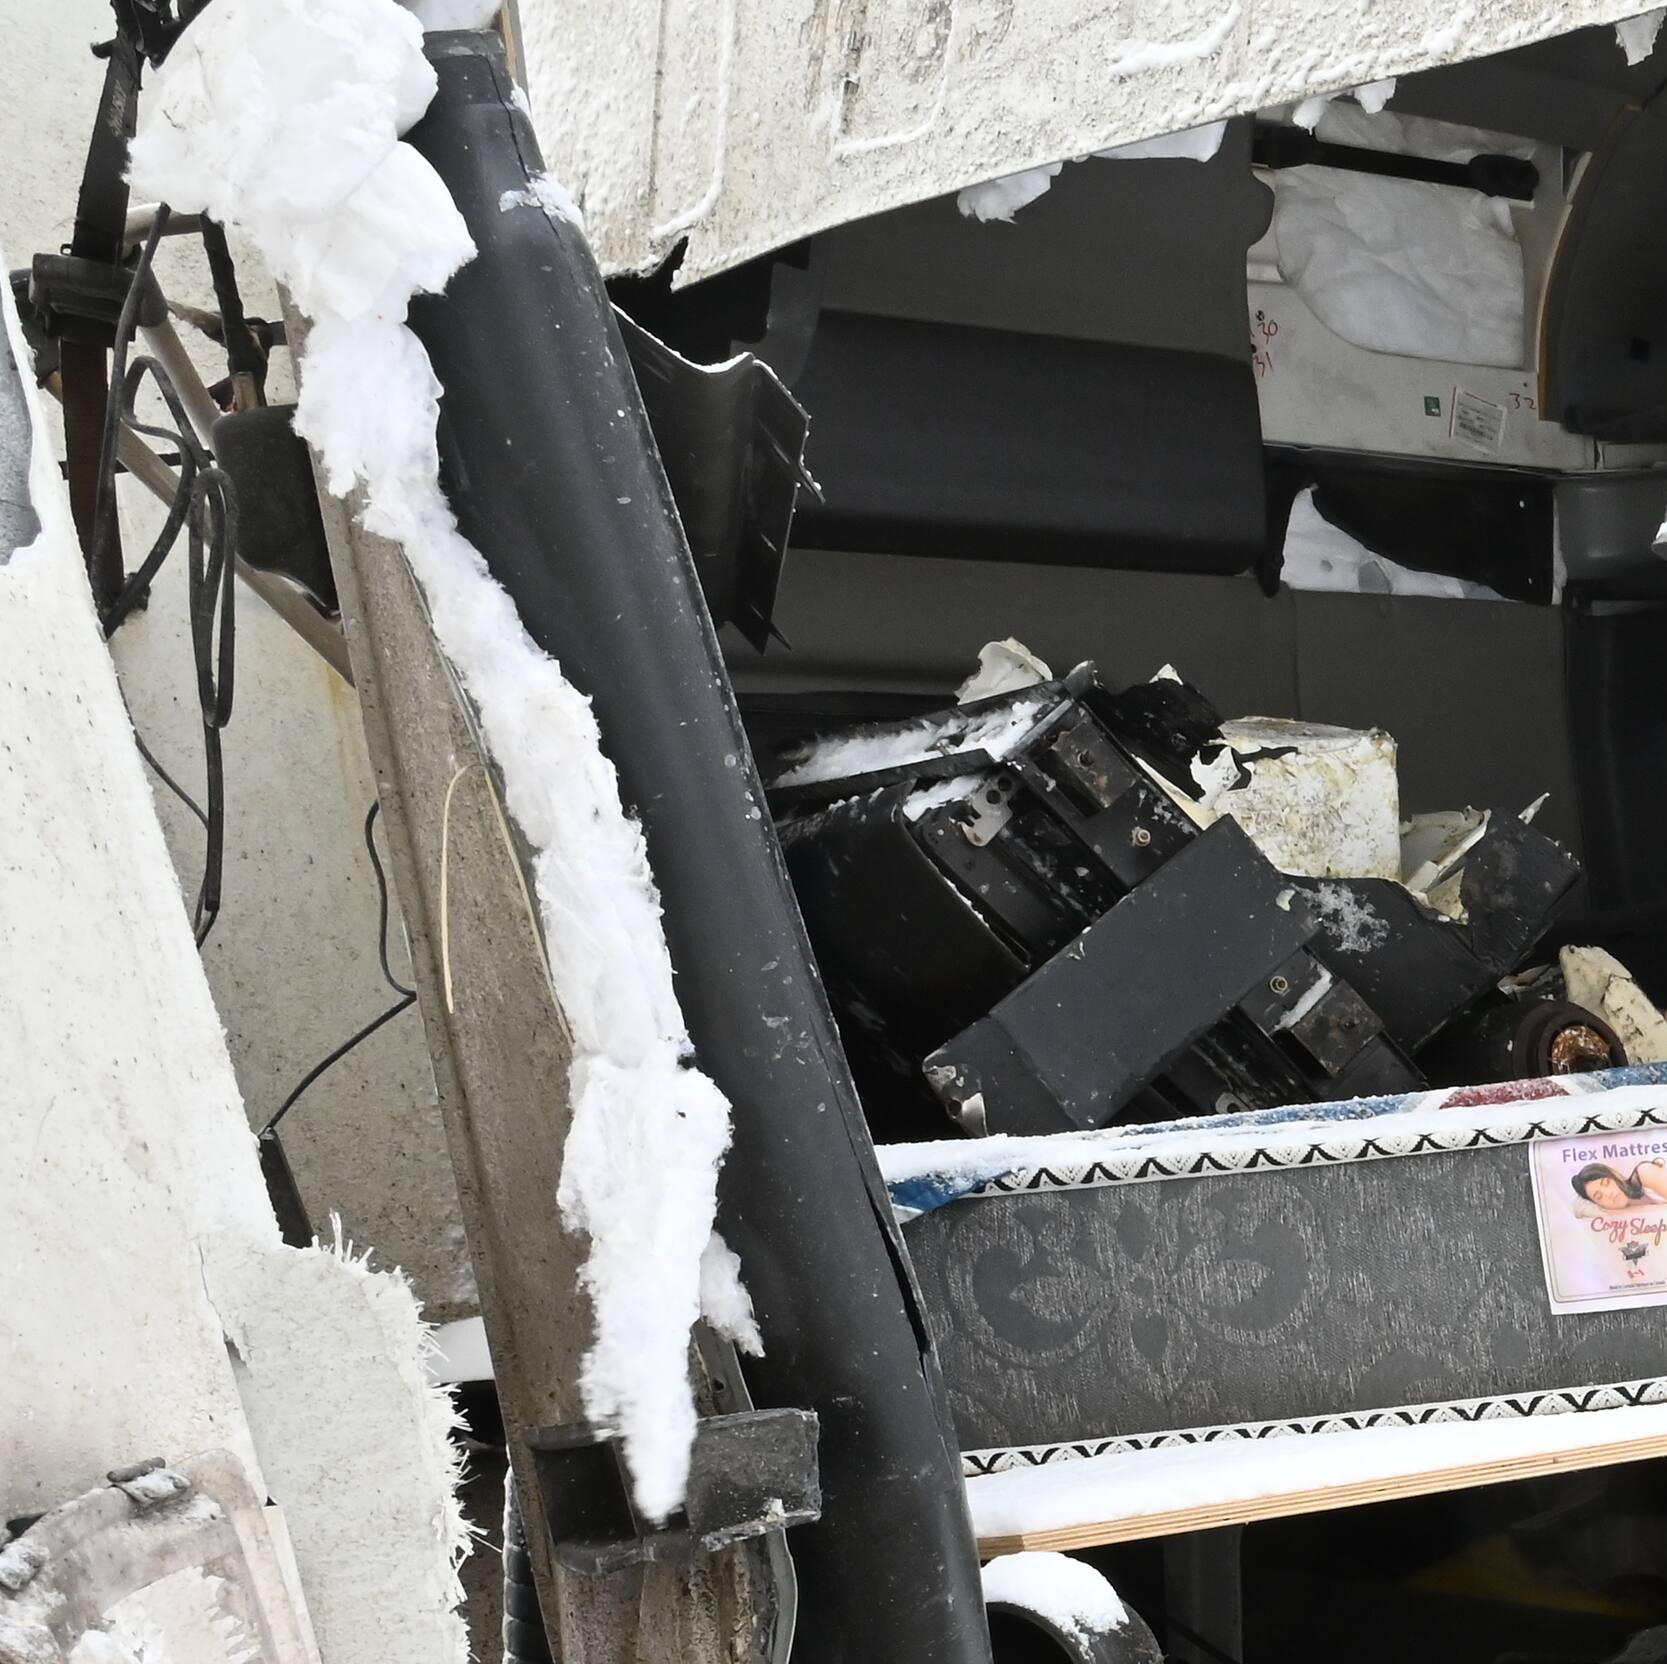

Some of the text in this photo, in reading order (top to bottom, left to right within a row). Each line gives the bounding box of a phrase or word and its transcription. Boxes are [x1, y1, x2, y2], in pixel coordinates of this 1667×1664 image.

[1508, 392, 1537, 410] 32
[1562, 1147, 1598, 1163] Flex
[1590, 1216, 1629, 1243] Cozy
